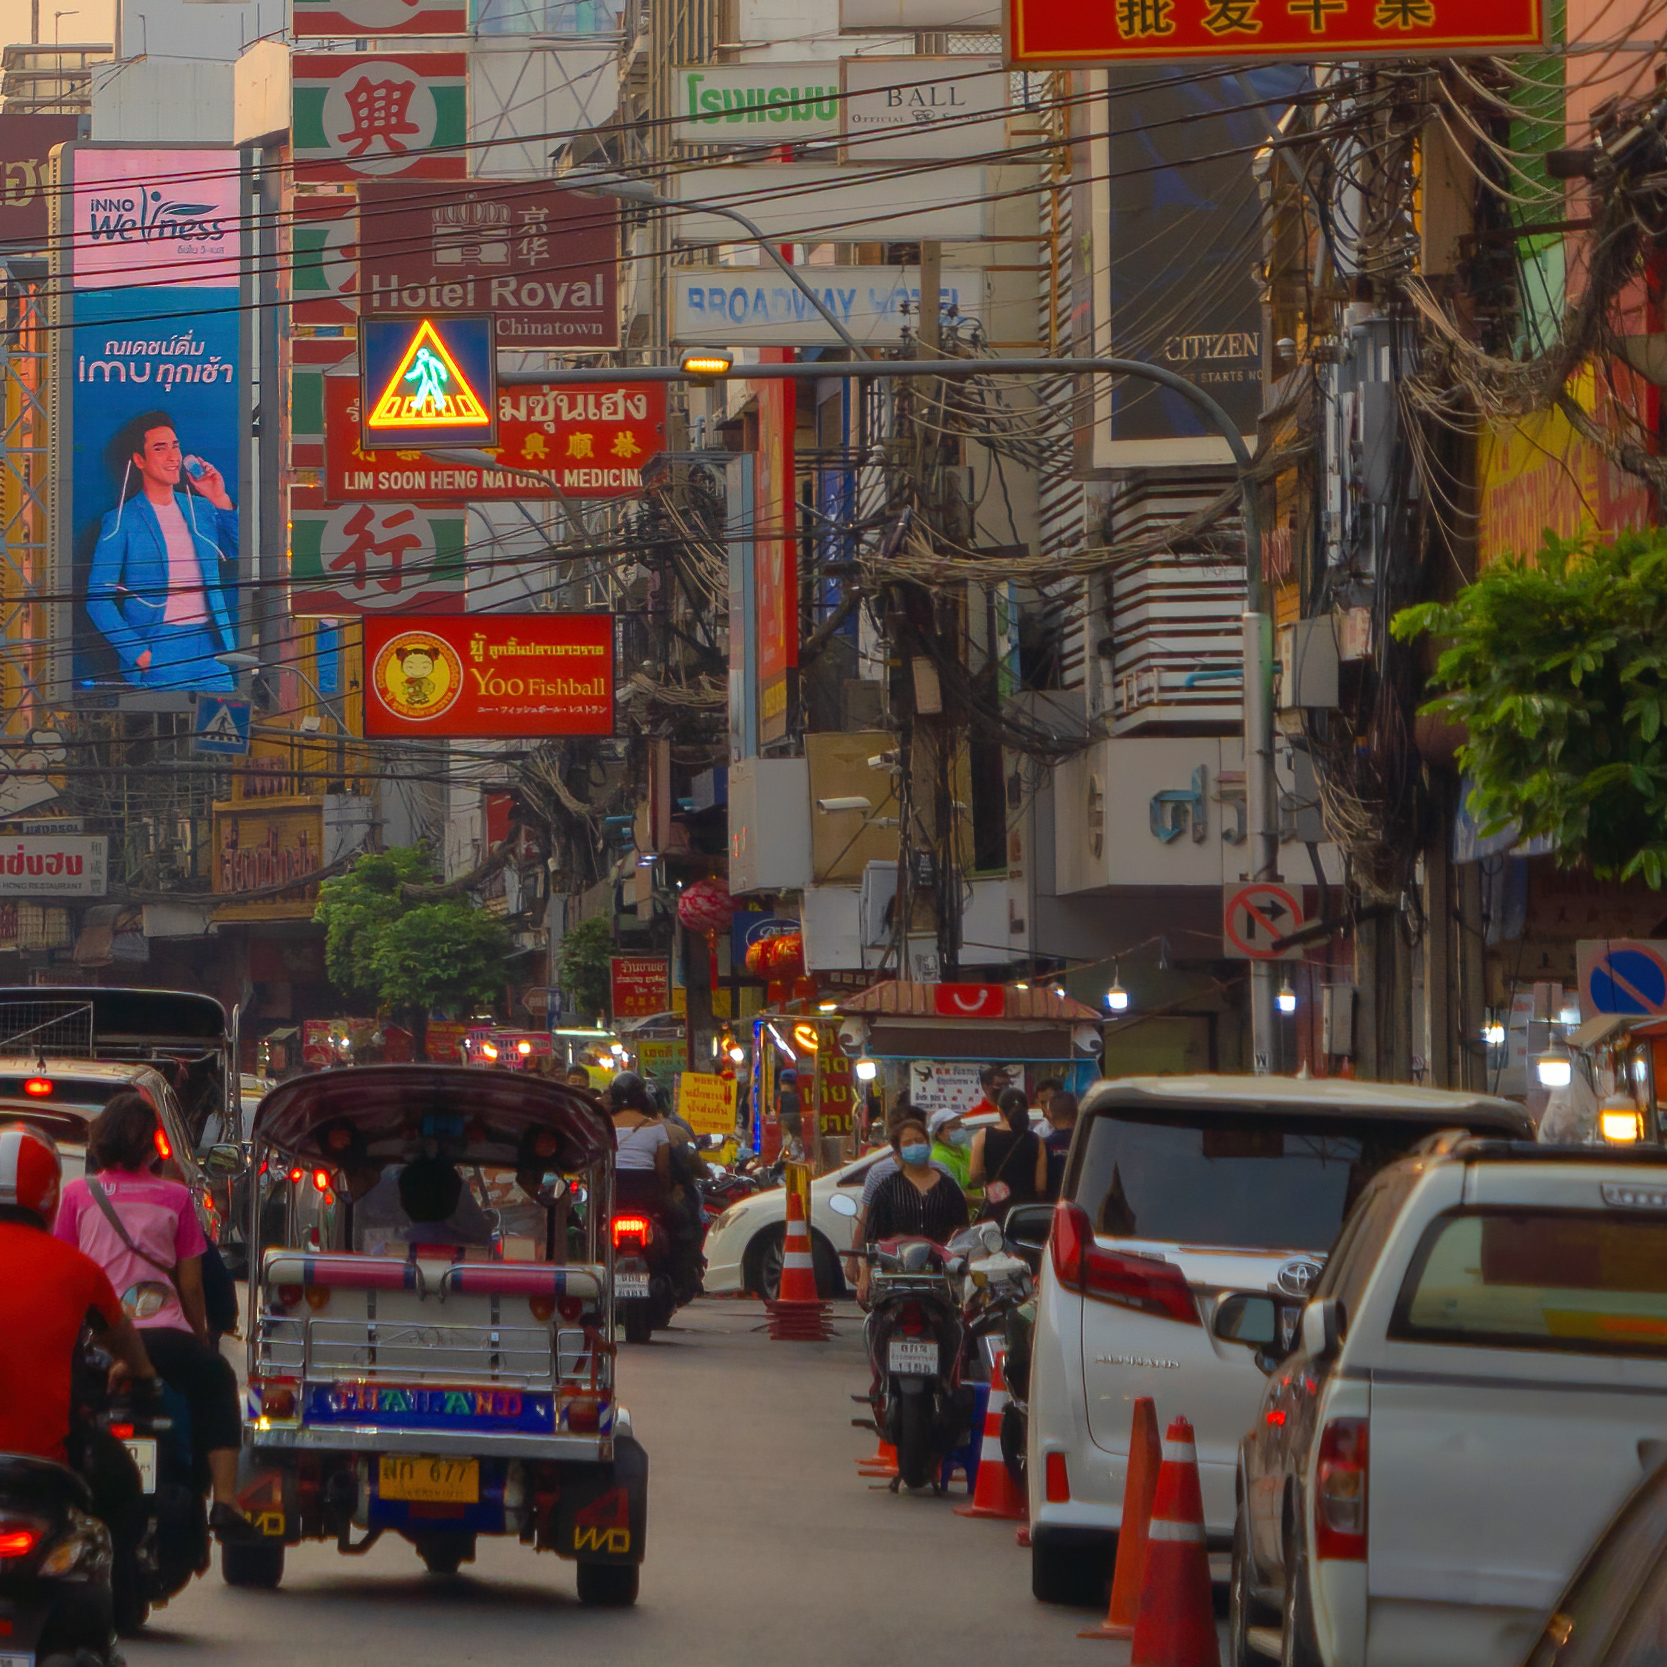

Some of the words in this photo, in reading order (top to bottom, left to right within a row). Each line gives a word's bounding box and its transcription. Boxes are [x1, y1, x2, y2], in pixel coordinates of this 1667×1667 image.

[886, 86, 966, 108] BALL
[372, 274, 475, 307] Hotel
[491, 273, 604, 310] Royal
[687, 286, 857, 325] BROADWAY
[496, 317, 603, 336] Chinatown
[1164, 331, 1260, 362] CITIZEN
[1200, 369, 1244, 384] STARTS
[344, 471, 374, 491] LIM
[378, 470, 427, 490] SOON
[431, 469, 478, 489] HENG
[527, 677, 607, 697] Fishball
[336, 1389, 522, 1416] THAILAND
